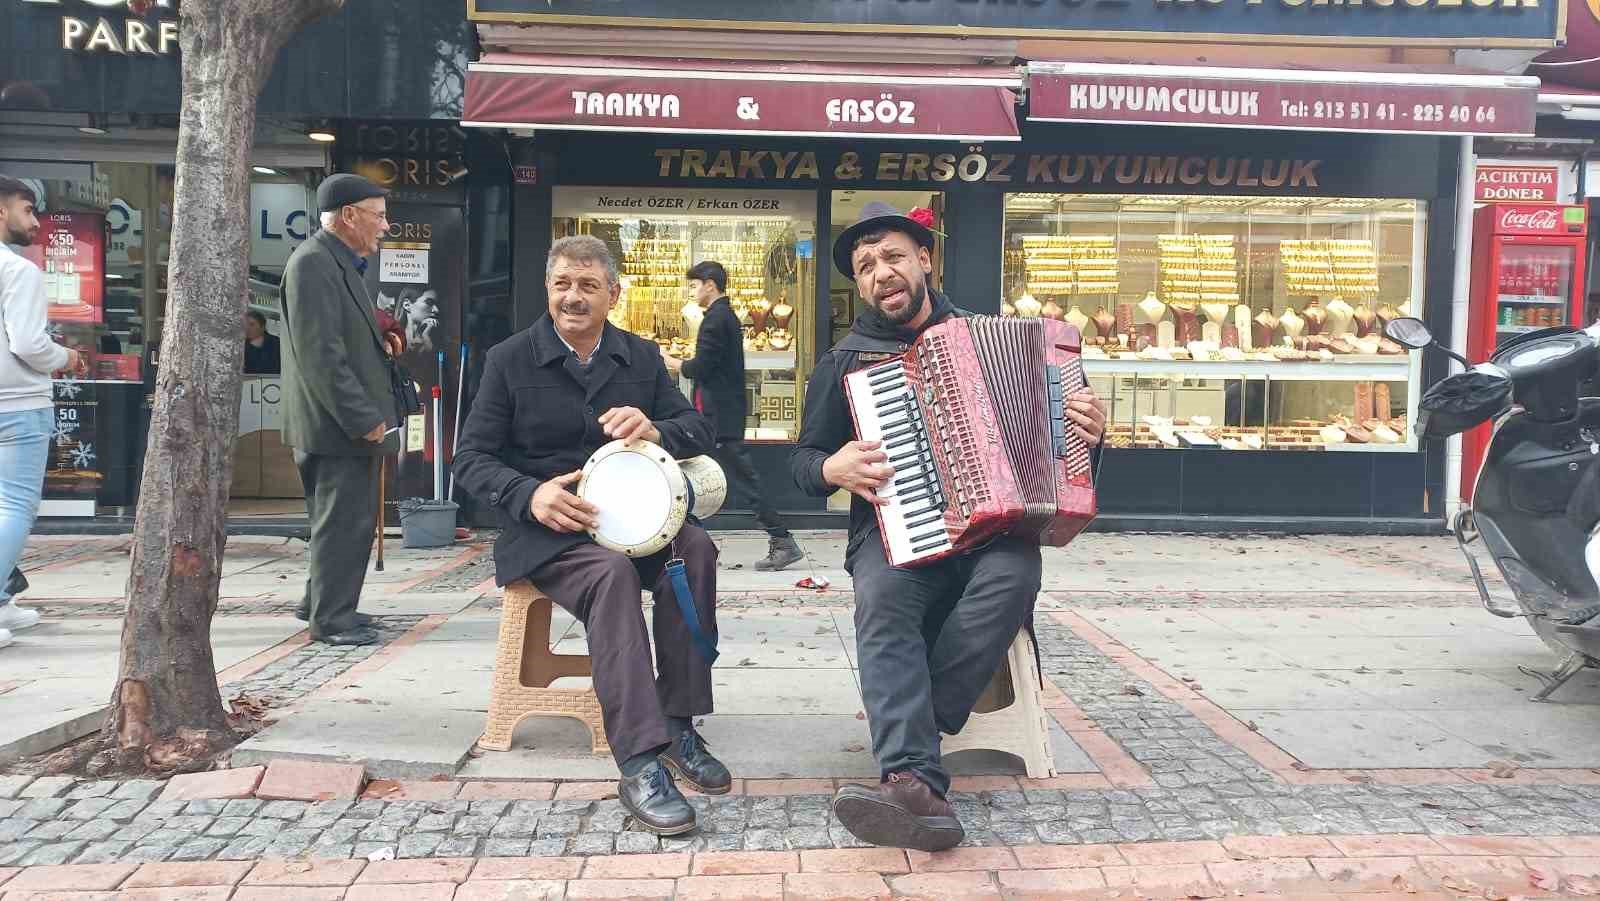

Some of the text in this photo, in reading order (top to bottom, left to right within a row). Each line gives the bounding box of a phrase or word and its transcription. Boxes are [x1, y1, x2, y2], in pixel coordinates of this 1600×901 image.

[572, 91, 915, 124] TRAKYA & ERSÖZ
[1069, 84, 1259, 117] KUYUMCULUK
[1280, 99, 1309, 117] Tel:
[1313, 101, 1344, 119] 213
[1350, 102, 1370, 119] 51
[1376, 103, 1396, 121] 41
[1413, 104, 1444, 121] 225
[1449, 106, 1470, 122] 40
[1475, 106, 1496, 123] 64
[654, 145, 1322, 188] TRAKYA & ERSÖZ KUYUMCULUK
[1477, 171, 1553, 184] ACIKTIM
[1484, 186, 1544, 200] DÖNER
[597, 196, 642, 208] Necdet
[697, 198, 738, 209] Erkan
[1502, 209, 1560, 230] Coca-Cola
[388, 222, 432, 239] ORIS
[48, 233, 74, 246] %50
